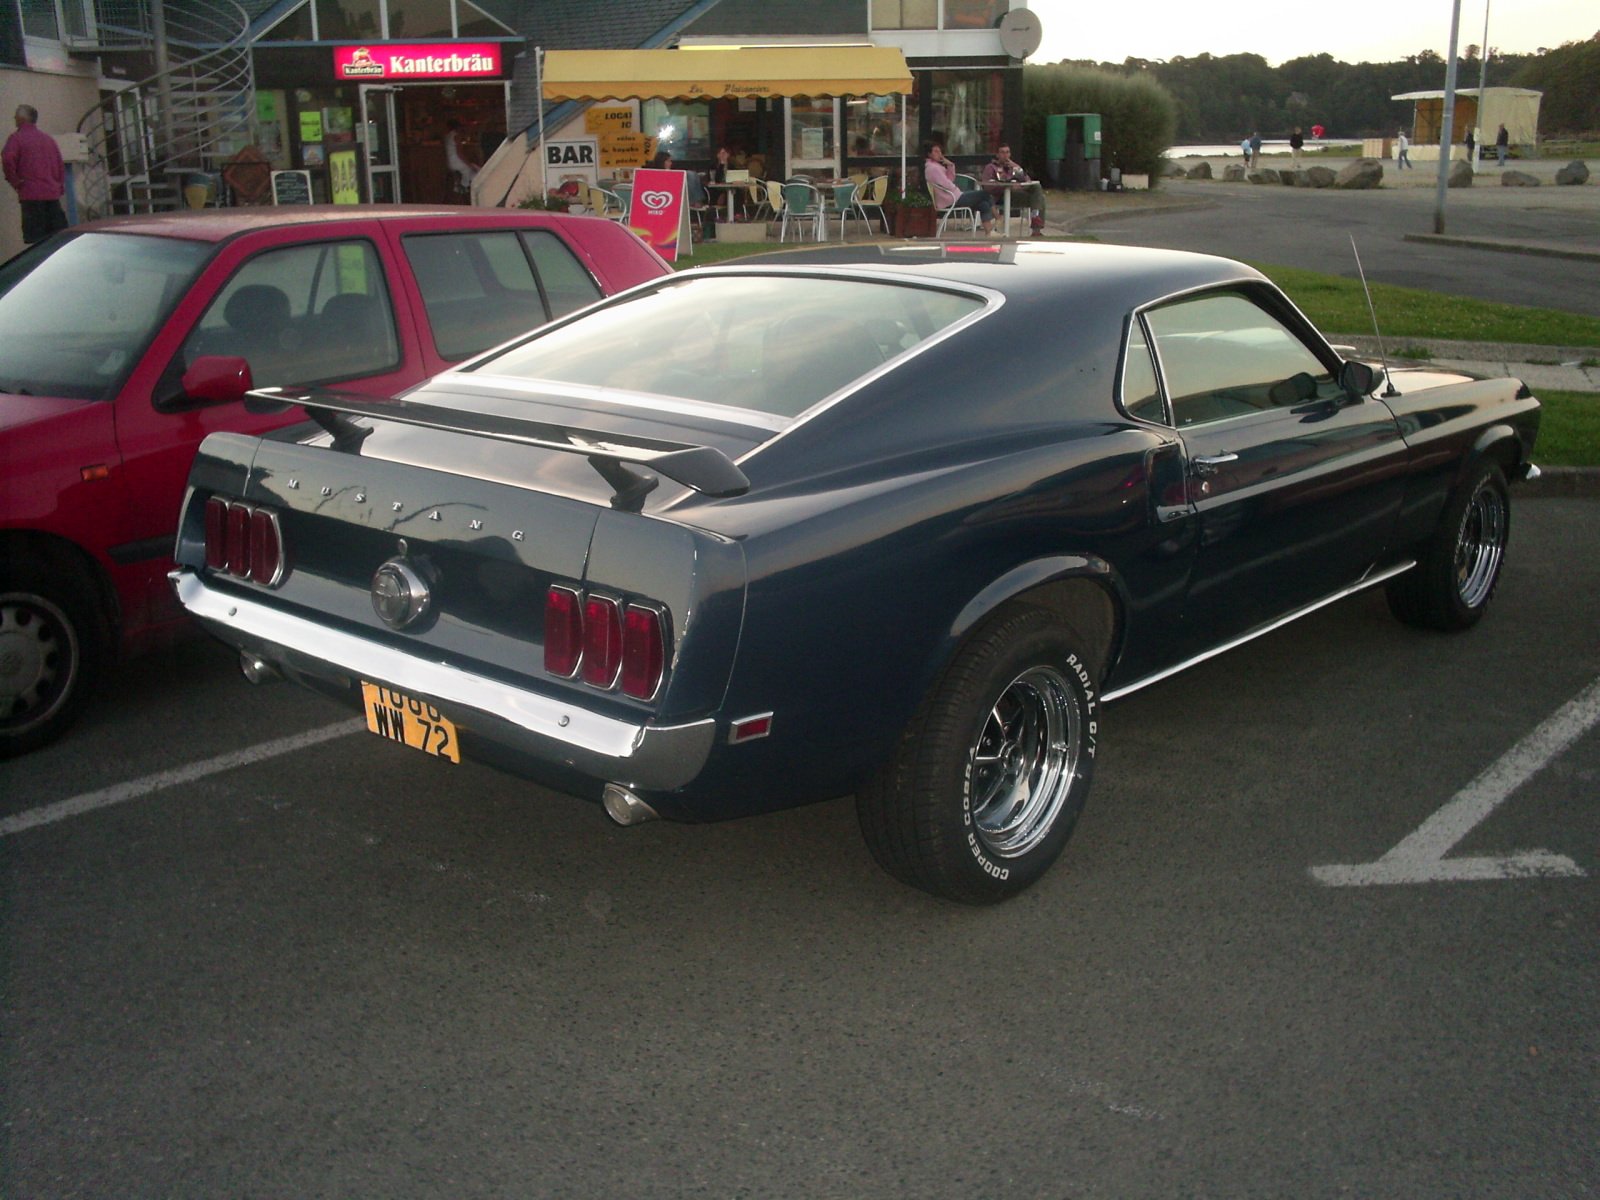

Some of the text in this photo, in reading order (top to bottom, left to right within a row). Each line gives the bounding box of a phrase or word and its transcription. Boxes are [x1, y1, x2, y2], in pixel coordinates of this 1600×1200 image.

[389, 53, 494, 73] Kanterbräu
[547, 144, 594, 165] BAR
[286, 477, 527, 542] MUSTANG
[373, 702, 452, 760] WW 72
[1066, 653, 1097, 759] RADIAL G/T
[963, 747, 1010, 881] COOPER COBRA
